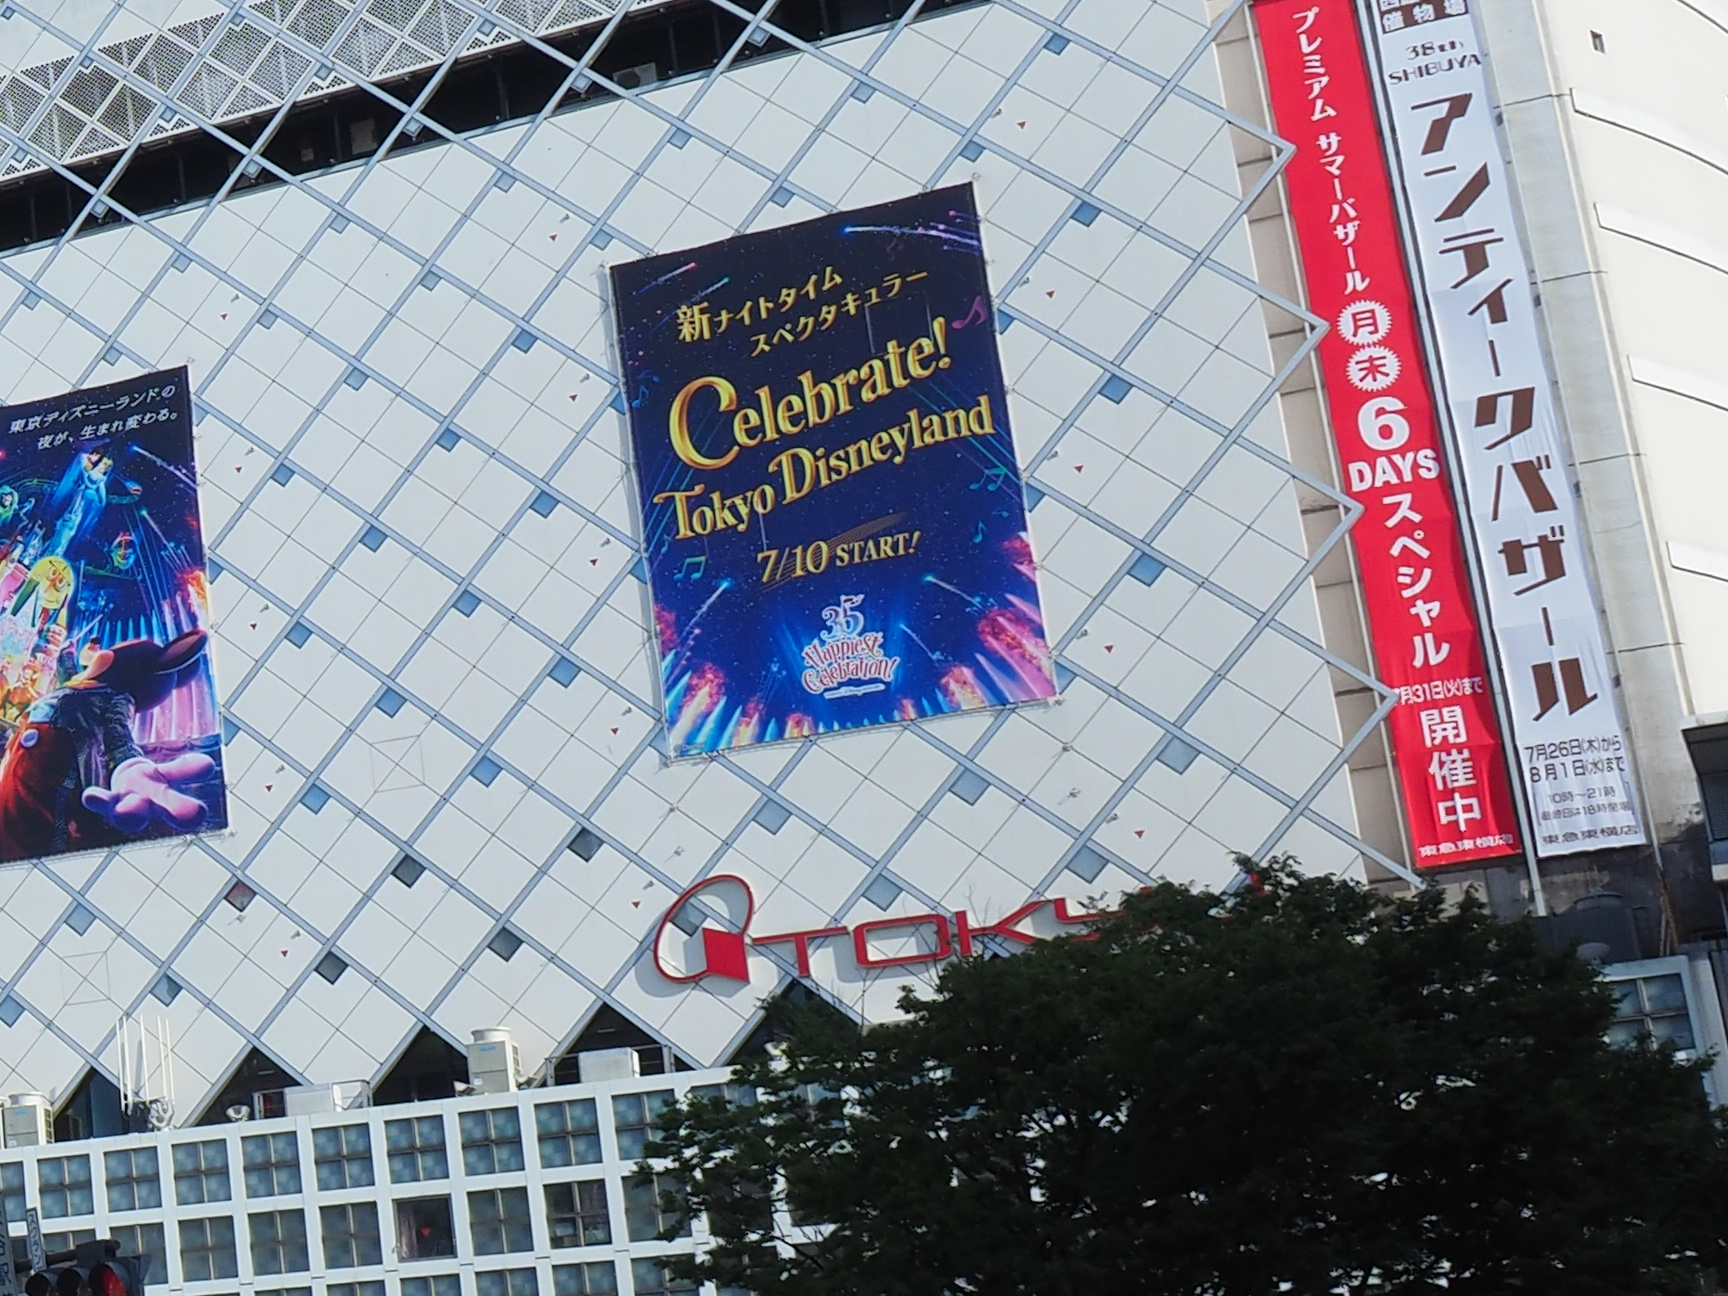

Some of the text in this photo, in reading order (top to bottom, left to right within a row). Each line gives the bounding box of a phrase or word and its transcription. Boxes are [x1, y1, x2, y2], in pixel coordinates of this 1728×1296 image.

[1388, 54, 1481, 85] SHIBUYA
[1291, 6, 1370, 294] プレミアム サマーバザール
[675, 265, 843, 344] 新ナイトタイム
[749, 270, 928, 358] スペクタキュラー
[8, 385, 176, 434] 東京ディズニーランドの
[37, 408, 178, 450] 夜が、生まれ変わる。
[668, 316, 952, 469] Celebrate!
[1410, 92, 1598, 722] アンティークバザール
[653, 395, 997, 541] Tokyo Disneyland
[1346, 306, 1450, 668] 月末 6 DAYS スペシャル
[757, 530, 923, 585] 7/10 START!
[801, 656, 901, 694] Celebration!
[802, 632, 884, 669] Happiest
[1419, 705, 1482, 833] 開催中
[1524, 735, 1622, 764] 7月26日(木)から
